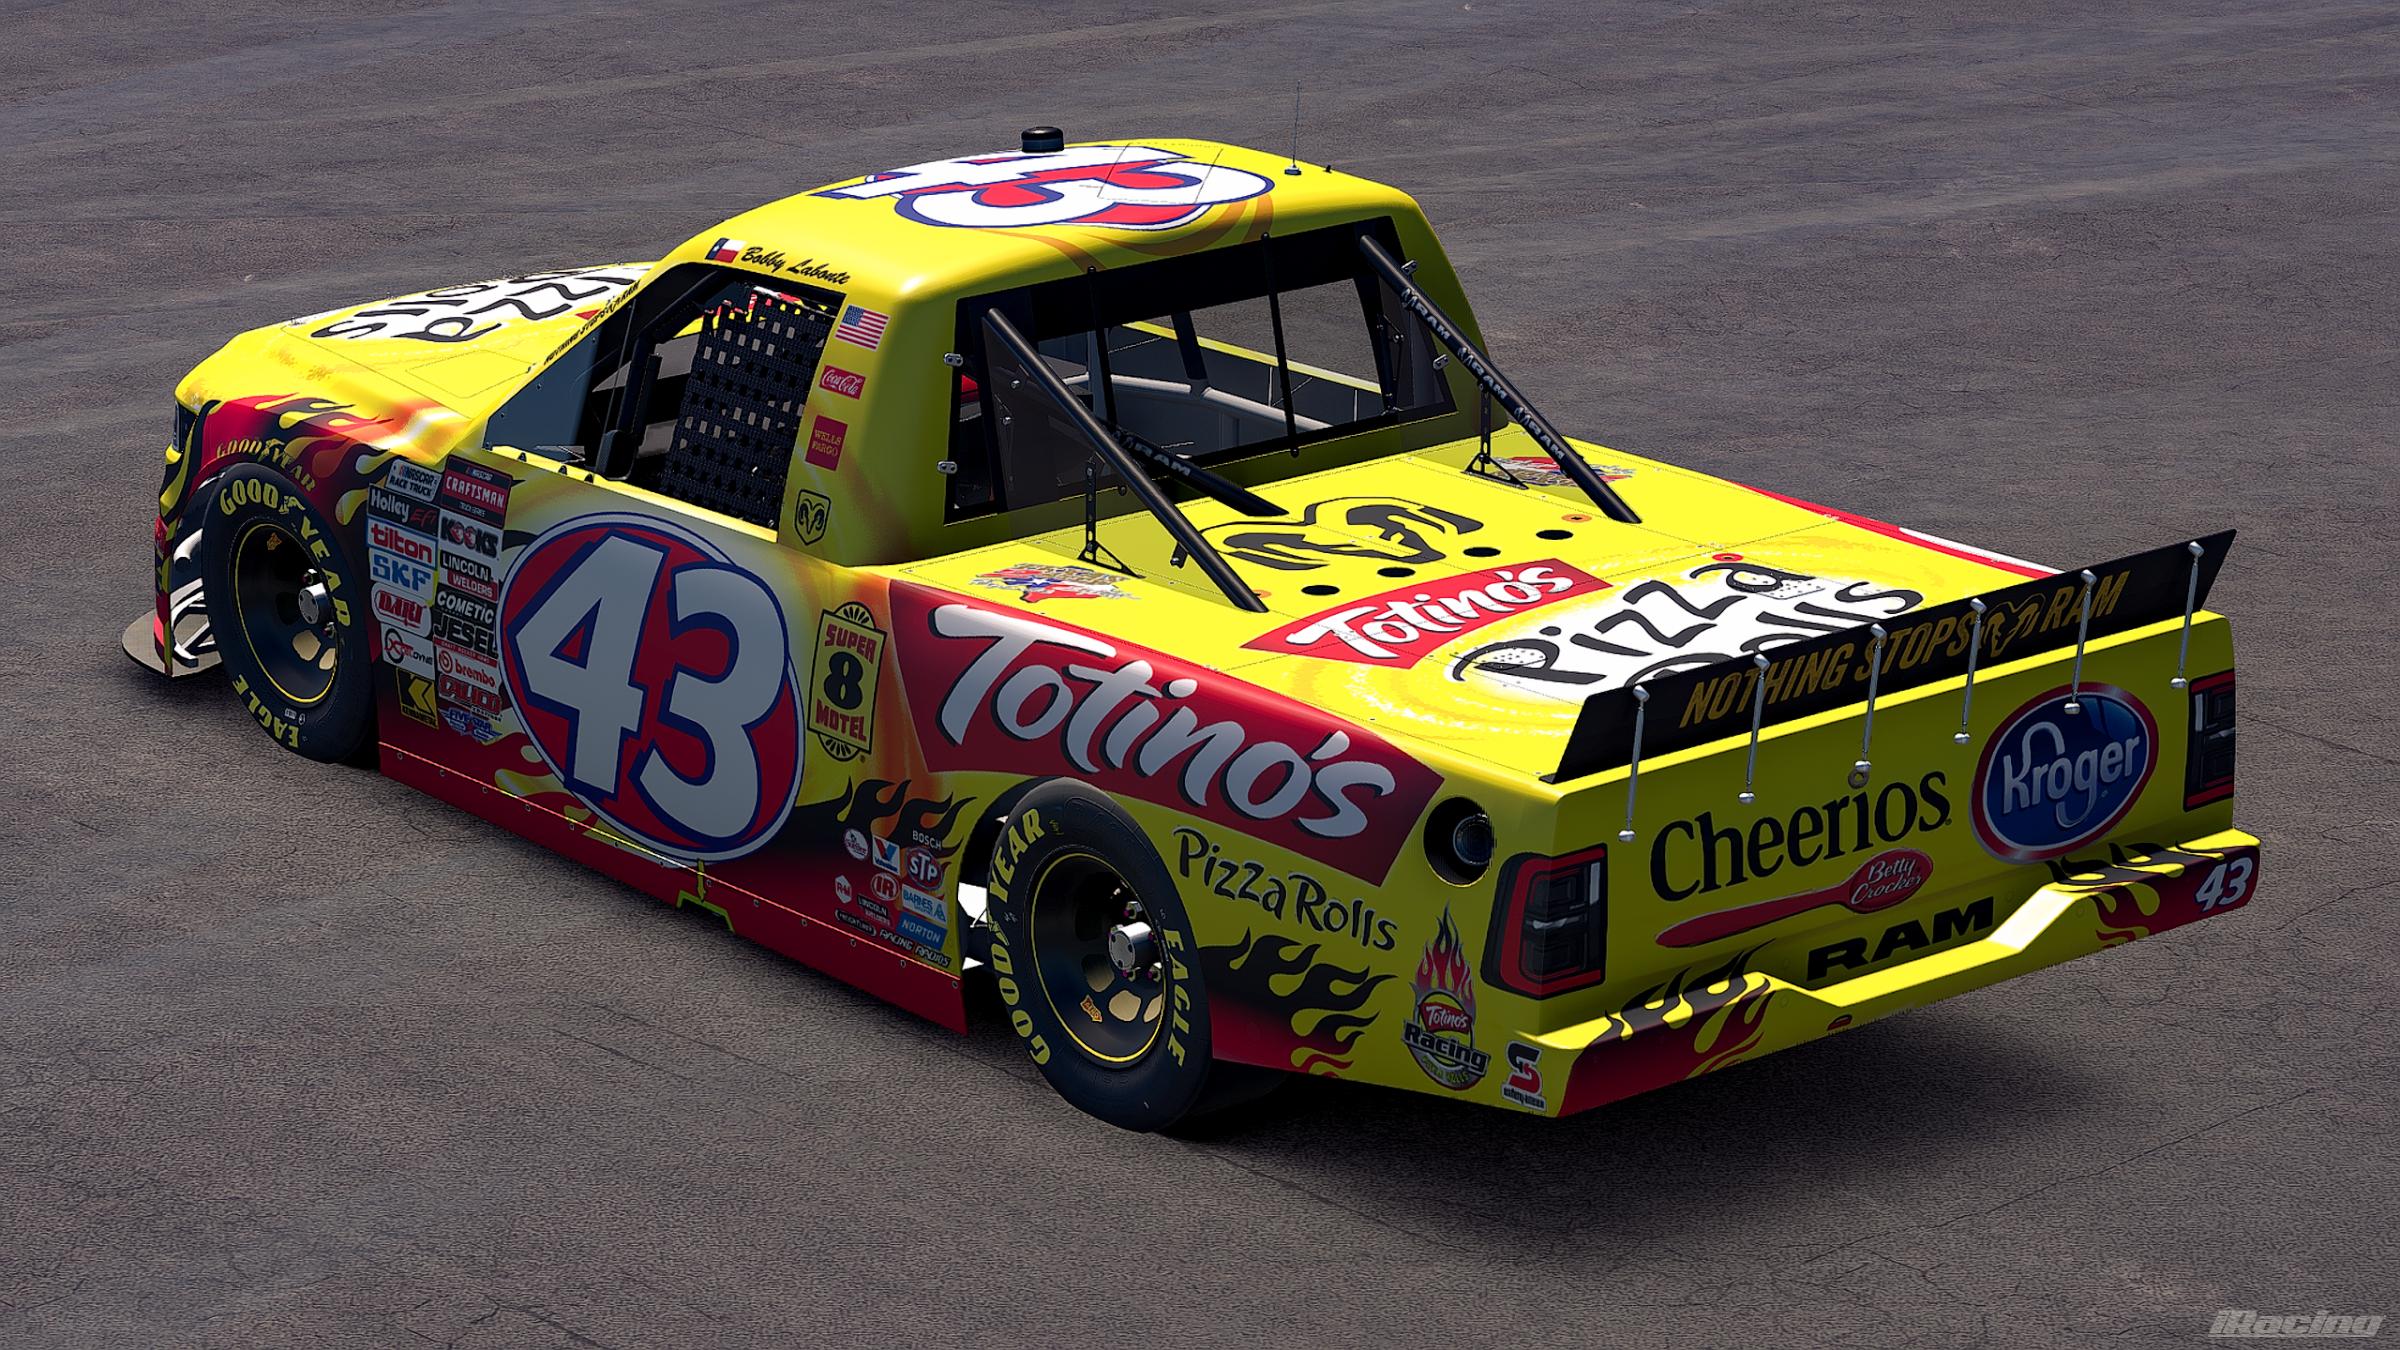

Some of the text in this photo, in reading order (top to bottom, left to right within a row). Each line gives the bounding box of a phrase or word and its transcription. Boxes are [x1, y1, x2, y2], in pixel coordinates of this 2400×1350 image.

[805, 144, 1276, 229] 43
[740, 246, 851, 286] Bobby Labonte
[1416, 303, 1450, 340] RAM
[1472, 361, 1507, 399] RAM
[811, 440, 839, 458] FARGO
[813, 429, 842, 446] WELLS
[1529, 420, 1565, 460] RAM
[1134, 441, 1192, 477] RAM
[370, 488, 410, 523] Holley
[445, 475, 506, 508] CRAFTSMAN
[370, 522, 432, 564] tilton
[372, 553, 432, 592] SKF
[442, 555, 490, 581] LINCOLN
[452, 573, 493, 598] WELDERS
[1285, 562, 1576, 660] Totino's
[1448, 562, 1817, 684] Pizza
[433, 613, 499, 659] JESEL
[824, 622, 877, 665] SUPER
[1678, 570, 2132, 729] NOTHING STOPS RAM
[455, 658, 496, 687] brembo
[508, 530, 790, 848] 43
[823, 650, 864, 711] 8
[231, 673, 301, 750] EAGLE
[815, 697, 868, 743] MOTEL
[928, 604, 1397, 840] Totino's
[2002, 721, 2141, 828] Kroger
[912, 829, 942, 850] BOSCH
[1649, 771, 1952, 902] Cheerios
[910, 851, 938, 882] STP
[1867, 857, 1917, 885] Betty
[2193, 856, 2253, 912] 43
[1173, 826, 1399, 952] Pizza Rolls
[1850, 875, 1923, 905] Crocker
[902, 919, 942, 943] NORTON
[1806, 896, 1995, 982] RAM
[1163, 928, 1191, 1067] EAGLE
[1425, 1005, 1469, 1029] Totino's
[1403, 1021, 1489, 1074] Racing
